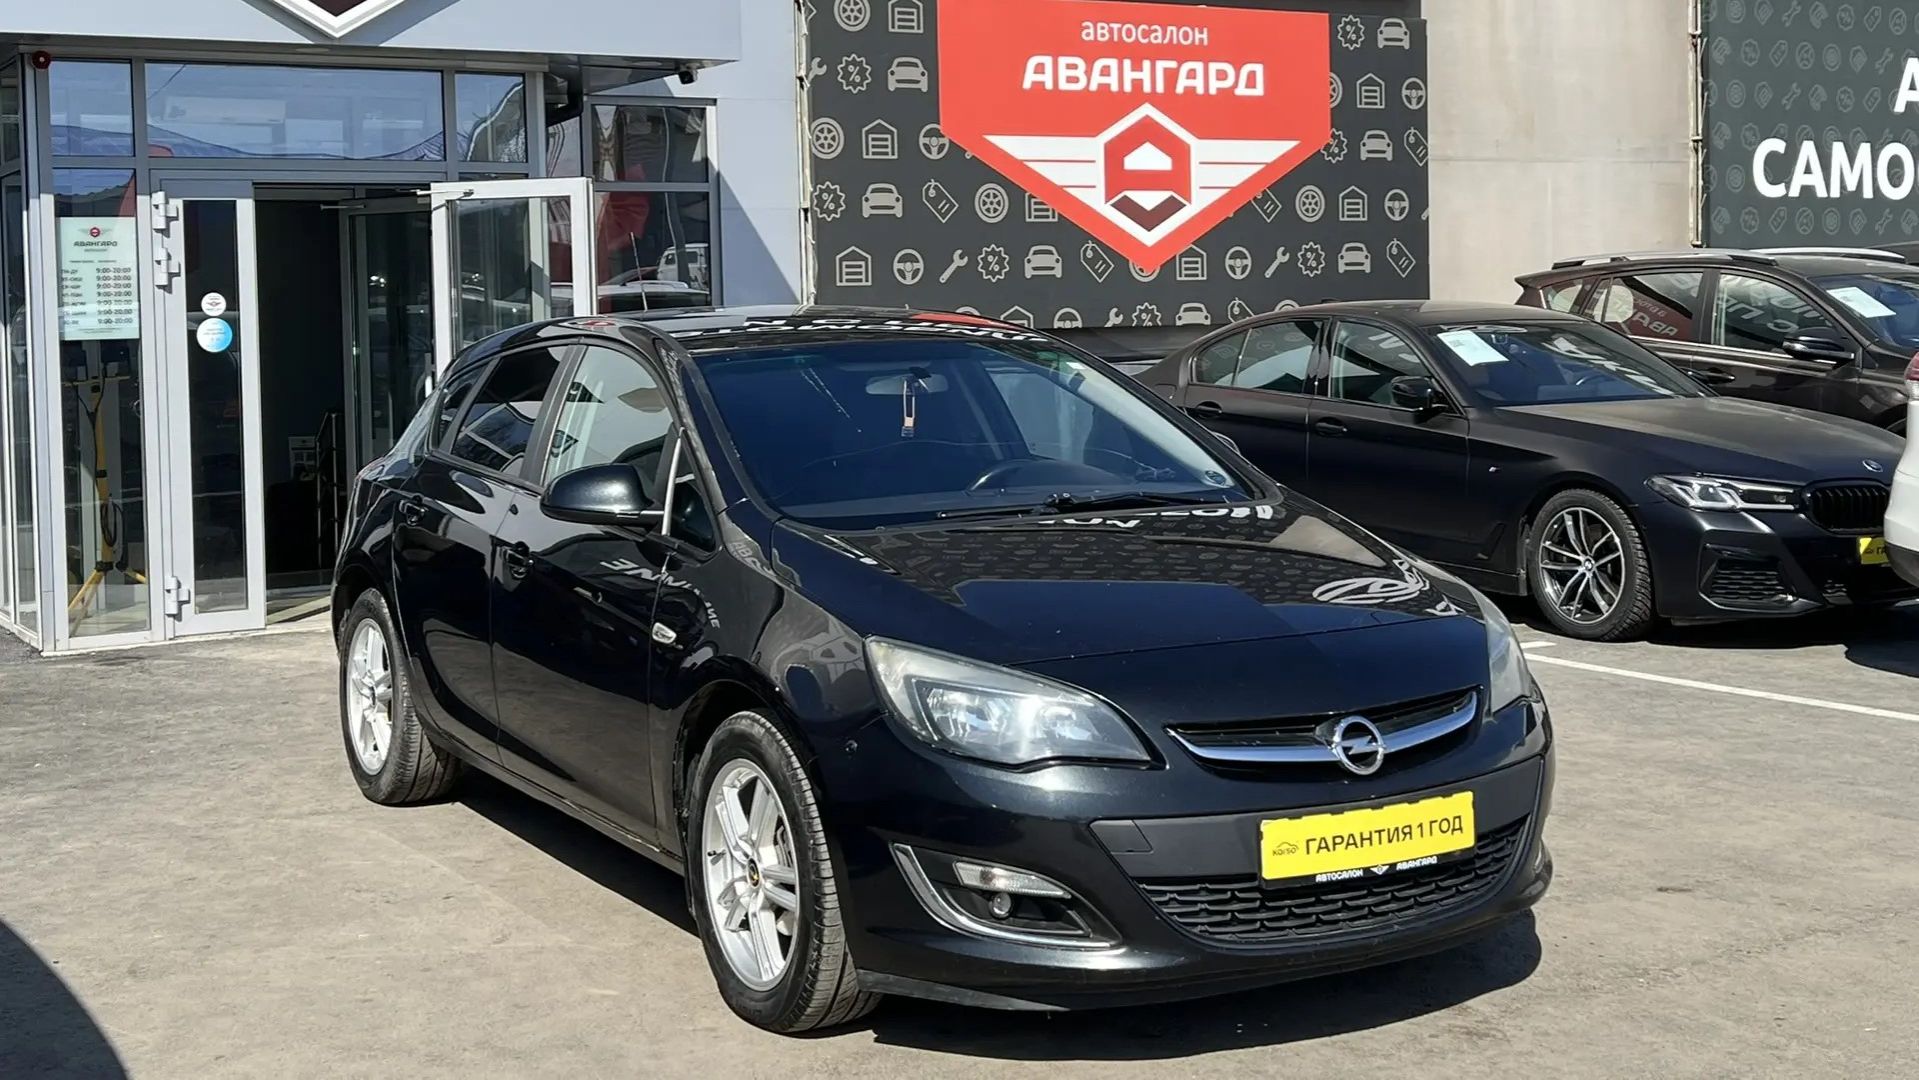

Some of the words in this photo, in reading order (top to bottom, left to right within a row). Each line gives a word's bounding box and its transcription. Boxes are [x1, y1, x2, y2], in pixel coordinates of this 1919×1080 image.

[1081, 21, 1208, 46] автосалон
[1022, 55, 1265, 96] АВАНГАРД
[1752, 137, 1919, 200] САМО
[1305, 824, 1413, 855] ГАРАНТИЯ
[1417, 822, 1424, 838] 1
[1429, 815, 1463, 837] ГОД
[1315, 868, 1364, 883] АВТОСАЛОН
[1396, 855, 1438, 871] АВАНГАРД
